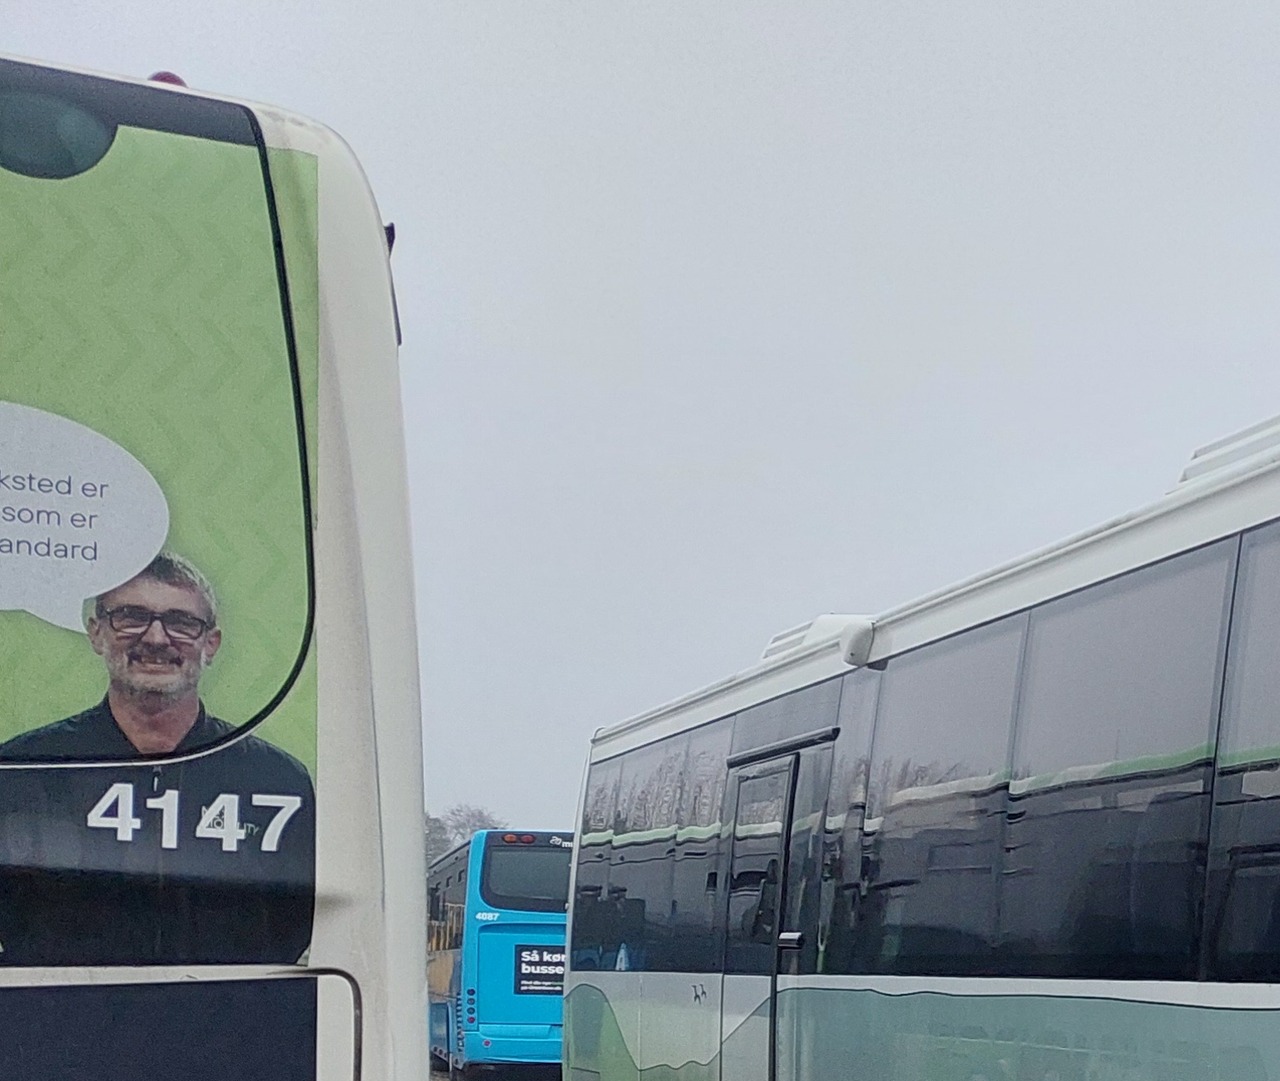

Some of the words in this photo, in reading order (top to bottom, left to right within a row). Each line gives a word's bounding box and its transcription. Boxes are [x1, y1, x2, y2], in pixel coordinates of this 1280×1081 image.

[81, 482, 109, 498] er
[1, 506, 61, 526] som
[70, 512, 98, 529] er
[0, 537, 97, 561] andard
[87, 783, 302, 852] 4147
[521, 950, 540, 961] Så
